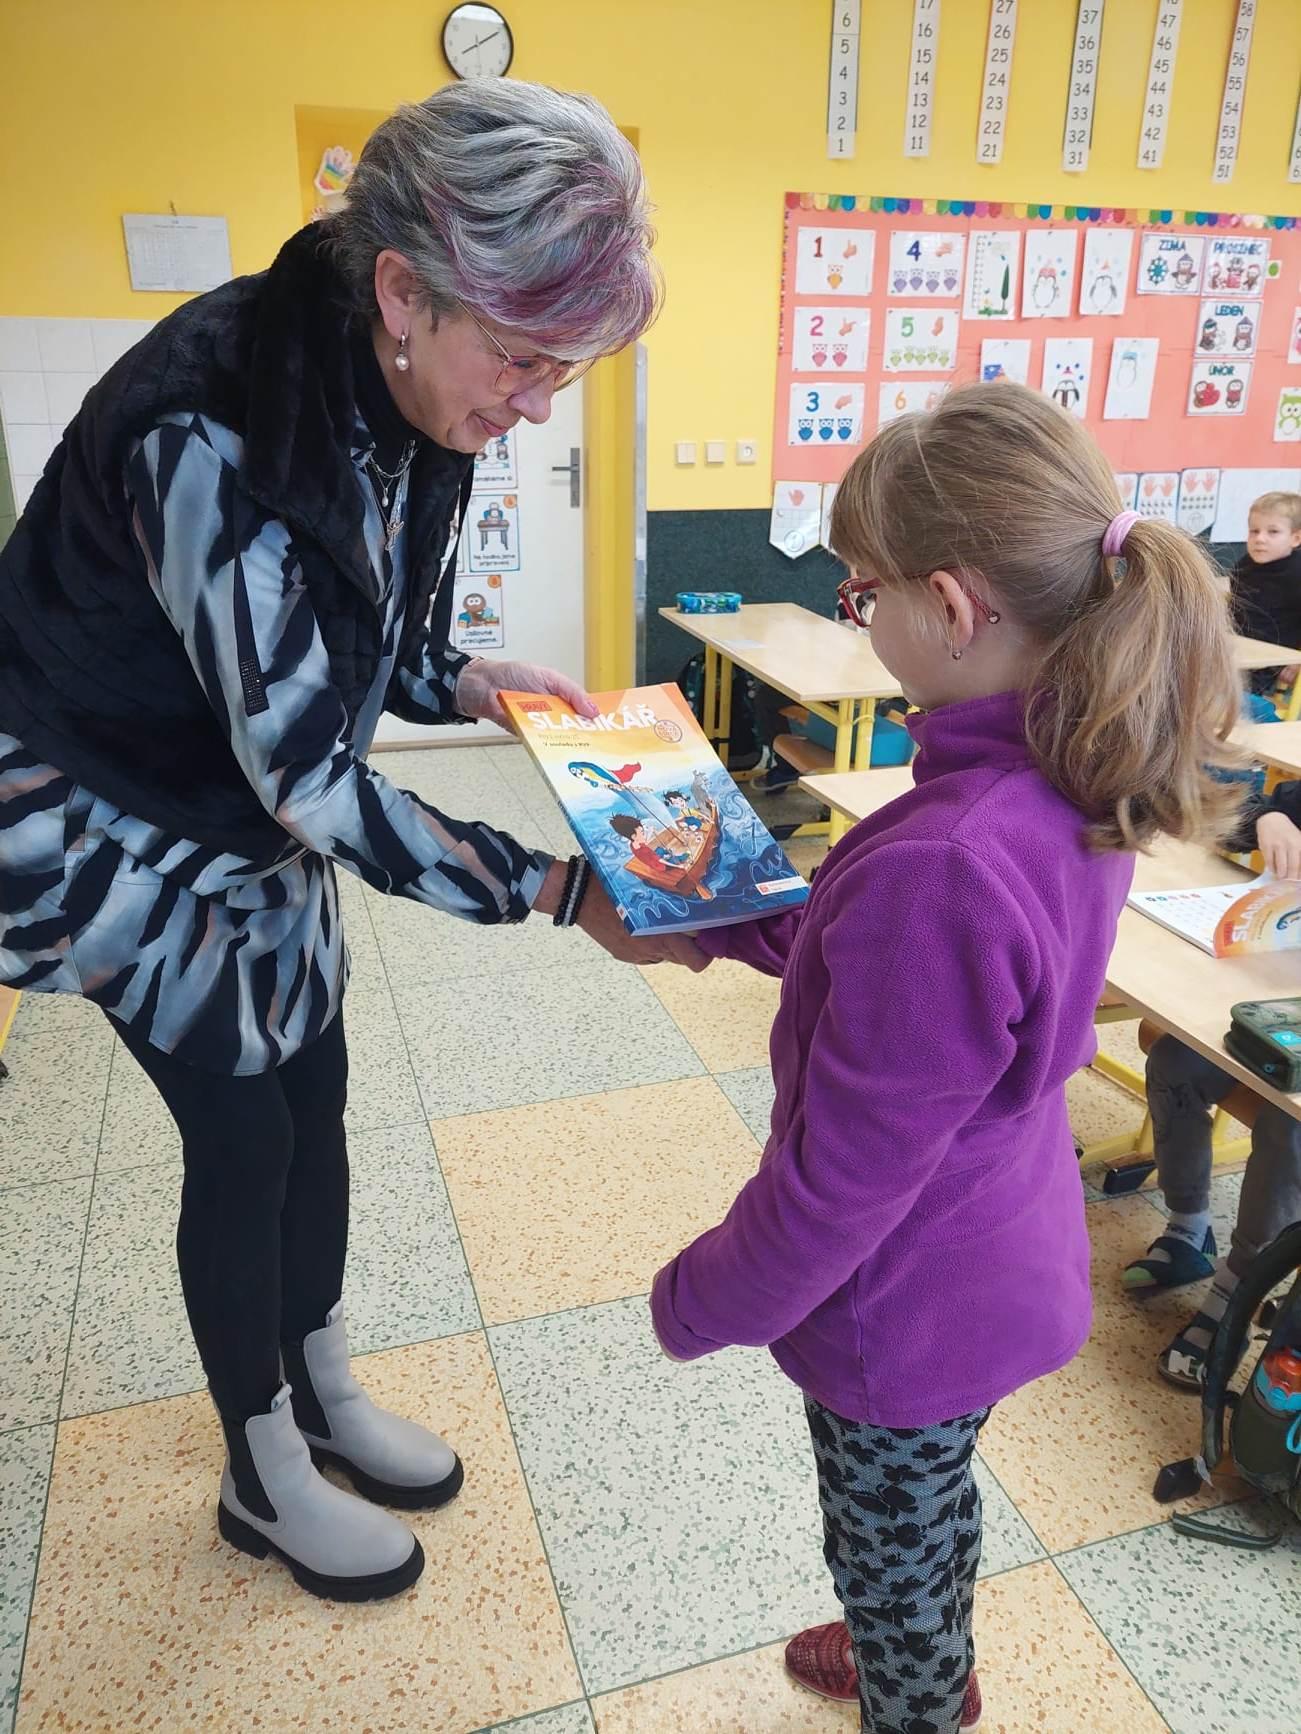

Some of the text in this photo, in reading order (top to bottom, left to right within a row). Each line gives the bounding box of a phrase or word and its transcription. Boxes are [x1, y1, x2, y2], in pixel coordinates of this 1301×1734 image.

[996, 0, 1014, 14] 27
[842, 12, 851, 28] 6
[1081, 9, 1099, 25] 37
[1160, 14, 1177, 29] 47
[918, 23, 933, 37] 16
[994, 24, 1011, 40] 26
[1236, 27, 1249, 41] 57
[840, 39, 850, 54] 5
[1078, 35, 1095, 50] 36
[1157, 36, 1172, 51] 46
[916, 49, 932, 64] 15
[991, 48, 1008, 63] 25
[1232, 52, 1245, 66] 56
[839, 66, 848, 80] 4
[1076, 59, 1093, 74] 35
[1154, 59, 1170, 74] 45
[914, 71, 929, 86] 14
[989, 73, 1006, 87] 24
[1228, 76, 1242, 90] 55
[1073, 83, 1090, 97] 34
[1150, 81, 1166, 94] 44
[839, 92, 848, 106] 3
[913, 93, 928, 107] 13
[986, 97, 1003, 111] 23
[1071, 107, 1089, 121] 33
[1148, 104, 1164, 118] 43
[1224, 101, 1239, 116] 54
[837, 116, 846, 130] 2
[912, 114, 927, 128] 12
[983, 121, 1001, 135] 22
[1068, 130, 1086, 144] 32
[1144, 127, 1161, 141] 42
[1221, 125, 1236, 140] 53
[837, 138, 844, 152] 1
[911, 136, 924, 150] 11
[982, 144, 997, 158] 21
[1068, 151, 1083, 165] 31
[1142, 150, 1157, 163] 41
[1219, 146, 1234, 160] 52
[1216, 165, 1230, 178] 51
[813, 236, 823, 258] 1
[907, 240, 922, 261] 4
[1159, 240, 1186, 251] ZIMA
[1215, 304, 1245, 316] LEDEN
[810, 315, 824, 337] 2
[901, 316, 914, 337] 5
[806, 391, 820, 412] 3
[895, 390, 906, 410] 6
[528, 704, 658, 731] SLABIKÁŘ
